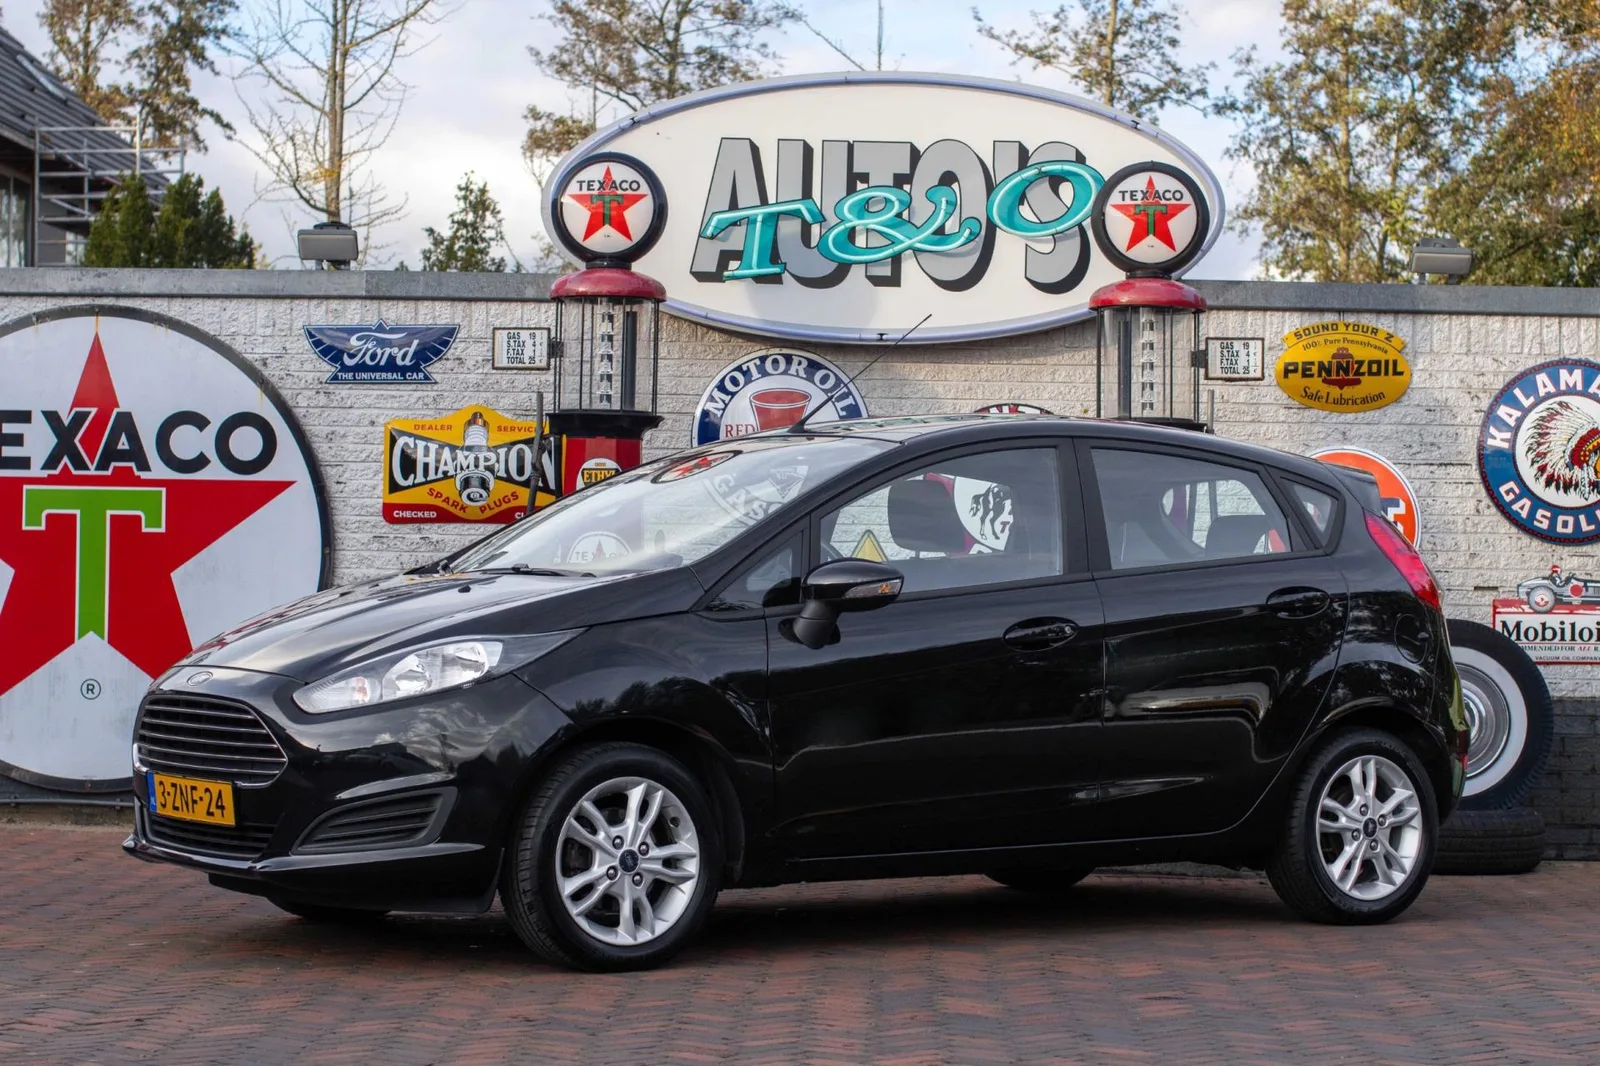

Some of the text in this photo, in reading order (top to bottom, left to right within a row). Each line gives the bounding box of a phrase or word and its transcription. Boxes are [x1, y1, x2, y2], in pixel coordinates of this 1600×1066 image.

[576, 180, 641, 192] TEXACO
[1119, 189, 1184, 202] TEXACO
[690, 137, 1092, 294] AUTO'S
[700, 198, 826, 281] T
[506, 332, 521, 340] GAS
[529, 332, 537, 340] 19
[1293, 322, 1395, 343] SOUND YOUR Z
[343, 331, 420, 367] Ford
[506, 340, 526, 348] S.TAX
[532, 340, 537, 348] 4
[1219, 341, 1234, 350] GAS
[1242, 342, 1250, 350] 19
[1323, 338, 1341, 346] Pure
[1342, 337, 1389, 355] Pennsylvania
[506, 348, 525, 356] F.TAX
[1219, 349, 1240, 358] S.TAX
[1245, 350, 1250, 358] 4
[506, 356, 526, 365] TOTAL
[528, 356, 536, 365] 25
[1219, 358, 1239, 366] F.TAX
[1219, 366, 1241, 375] TOTAL
[1242, 366, 1250, 375] 25
[1283, 359, 1405, 379] PENNZOIL
[337, 372, 424, 380] THE UNIVERSAL CAR
[703, 354, 856, 418] MOTOR OIL
[1300, 386, 1386, 407] Safe Lubrication
[413, 423, 453, 432] DEALER
[496, 425, 536, 433] SERVIC
[392, 433, 556, 490] CHAMPION
[426, 487, 520, 515] SPARK PLUGS
[393, 509, 437, 519] CHECKED
[158, 780, 226, 818] 3-ZNF-24
